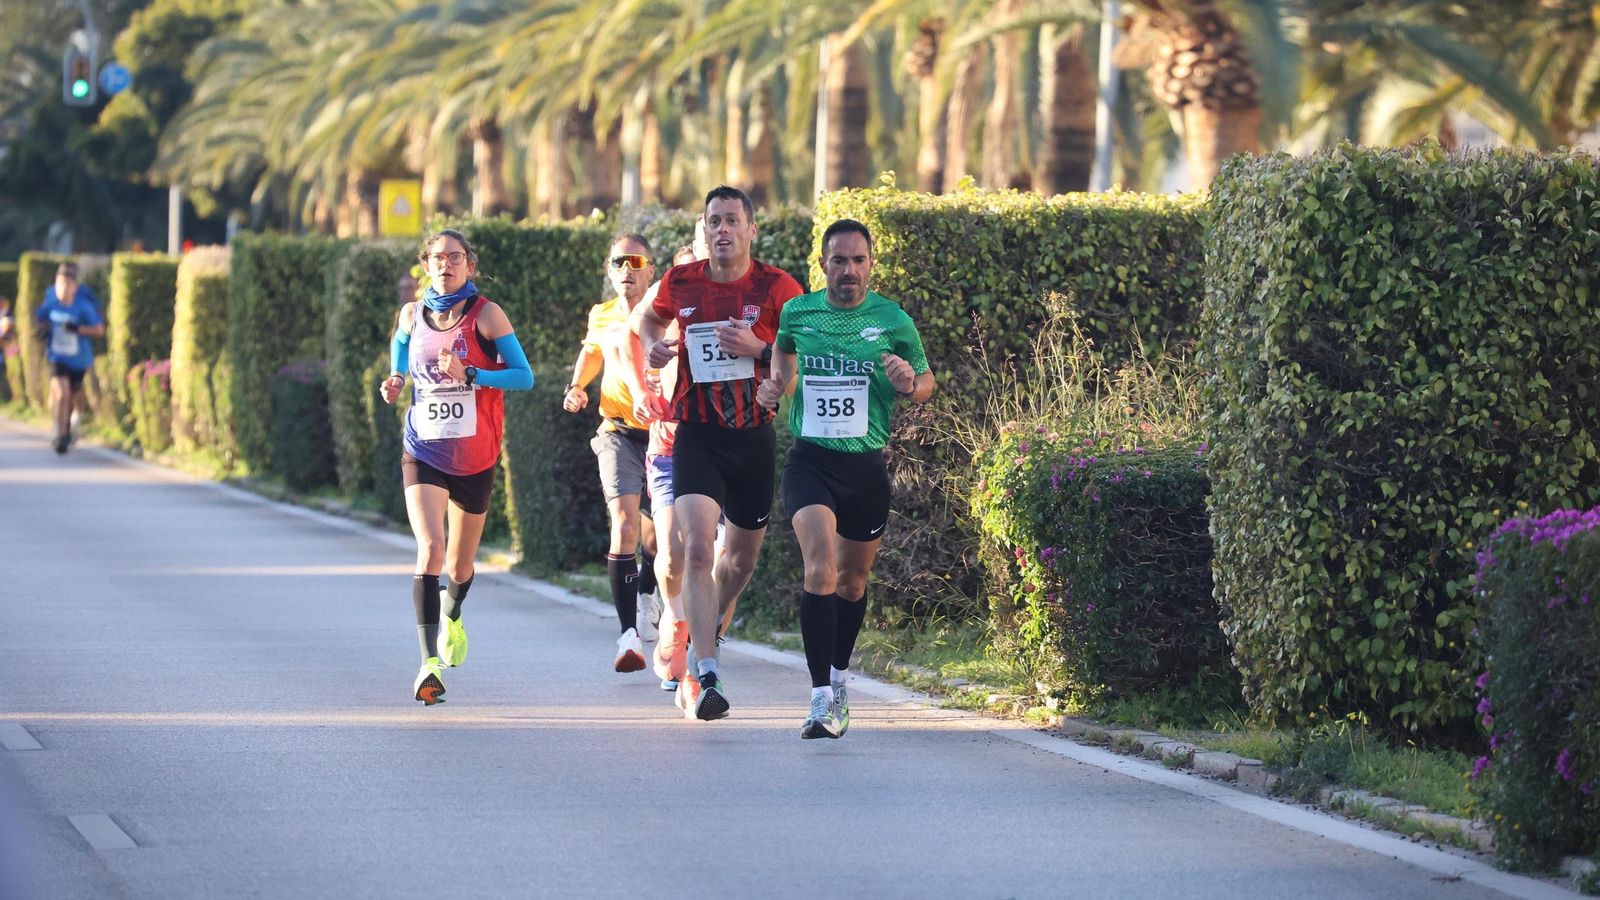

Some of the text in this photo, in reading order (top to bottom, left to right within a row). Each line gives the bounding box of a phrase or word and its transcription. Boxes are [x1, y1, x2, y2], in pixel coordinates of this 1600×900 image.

[702, 343, 739, 362] 51
[803, 352, 875, 376] mijas
[428, 402, 464, 420] 590
[816, 397, 855, 417] 358
